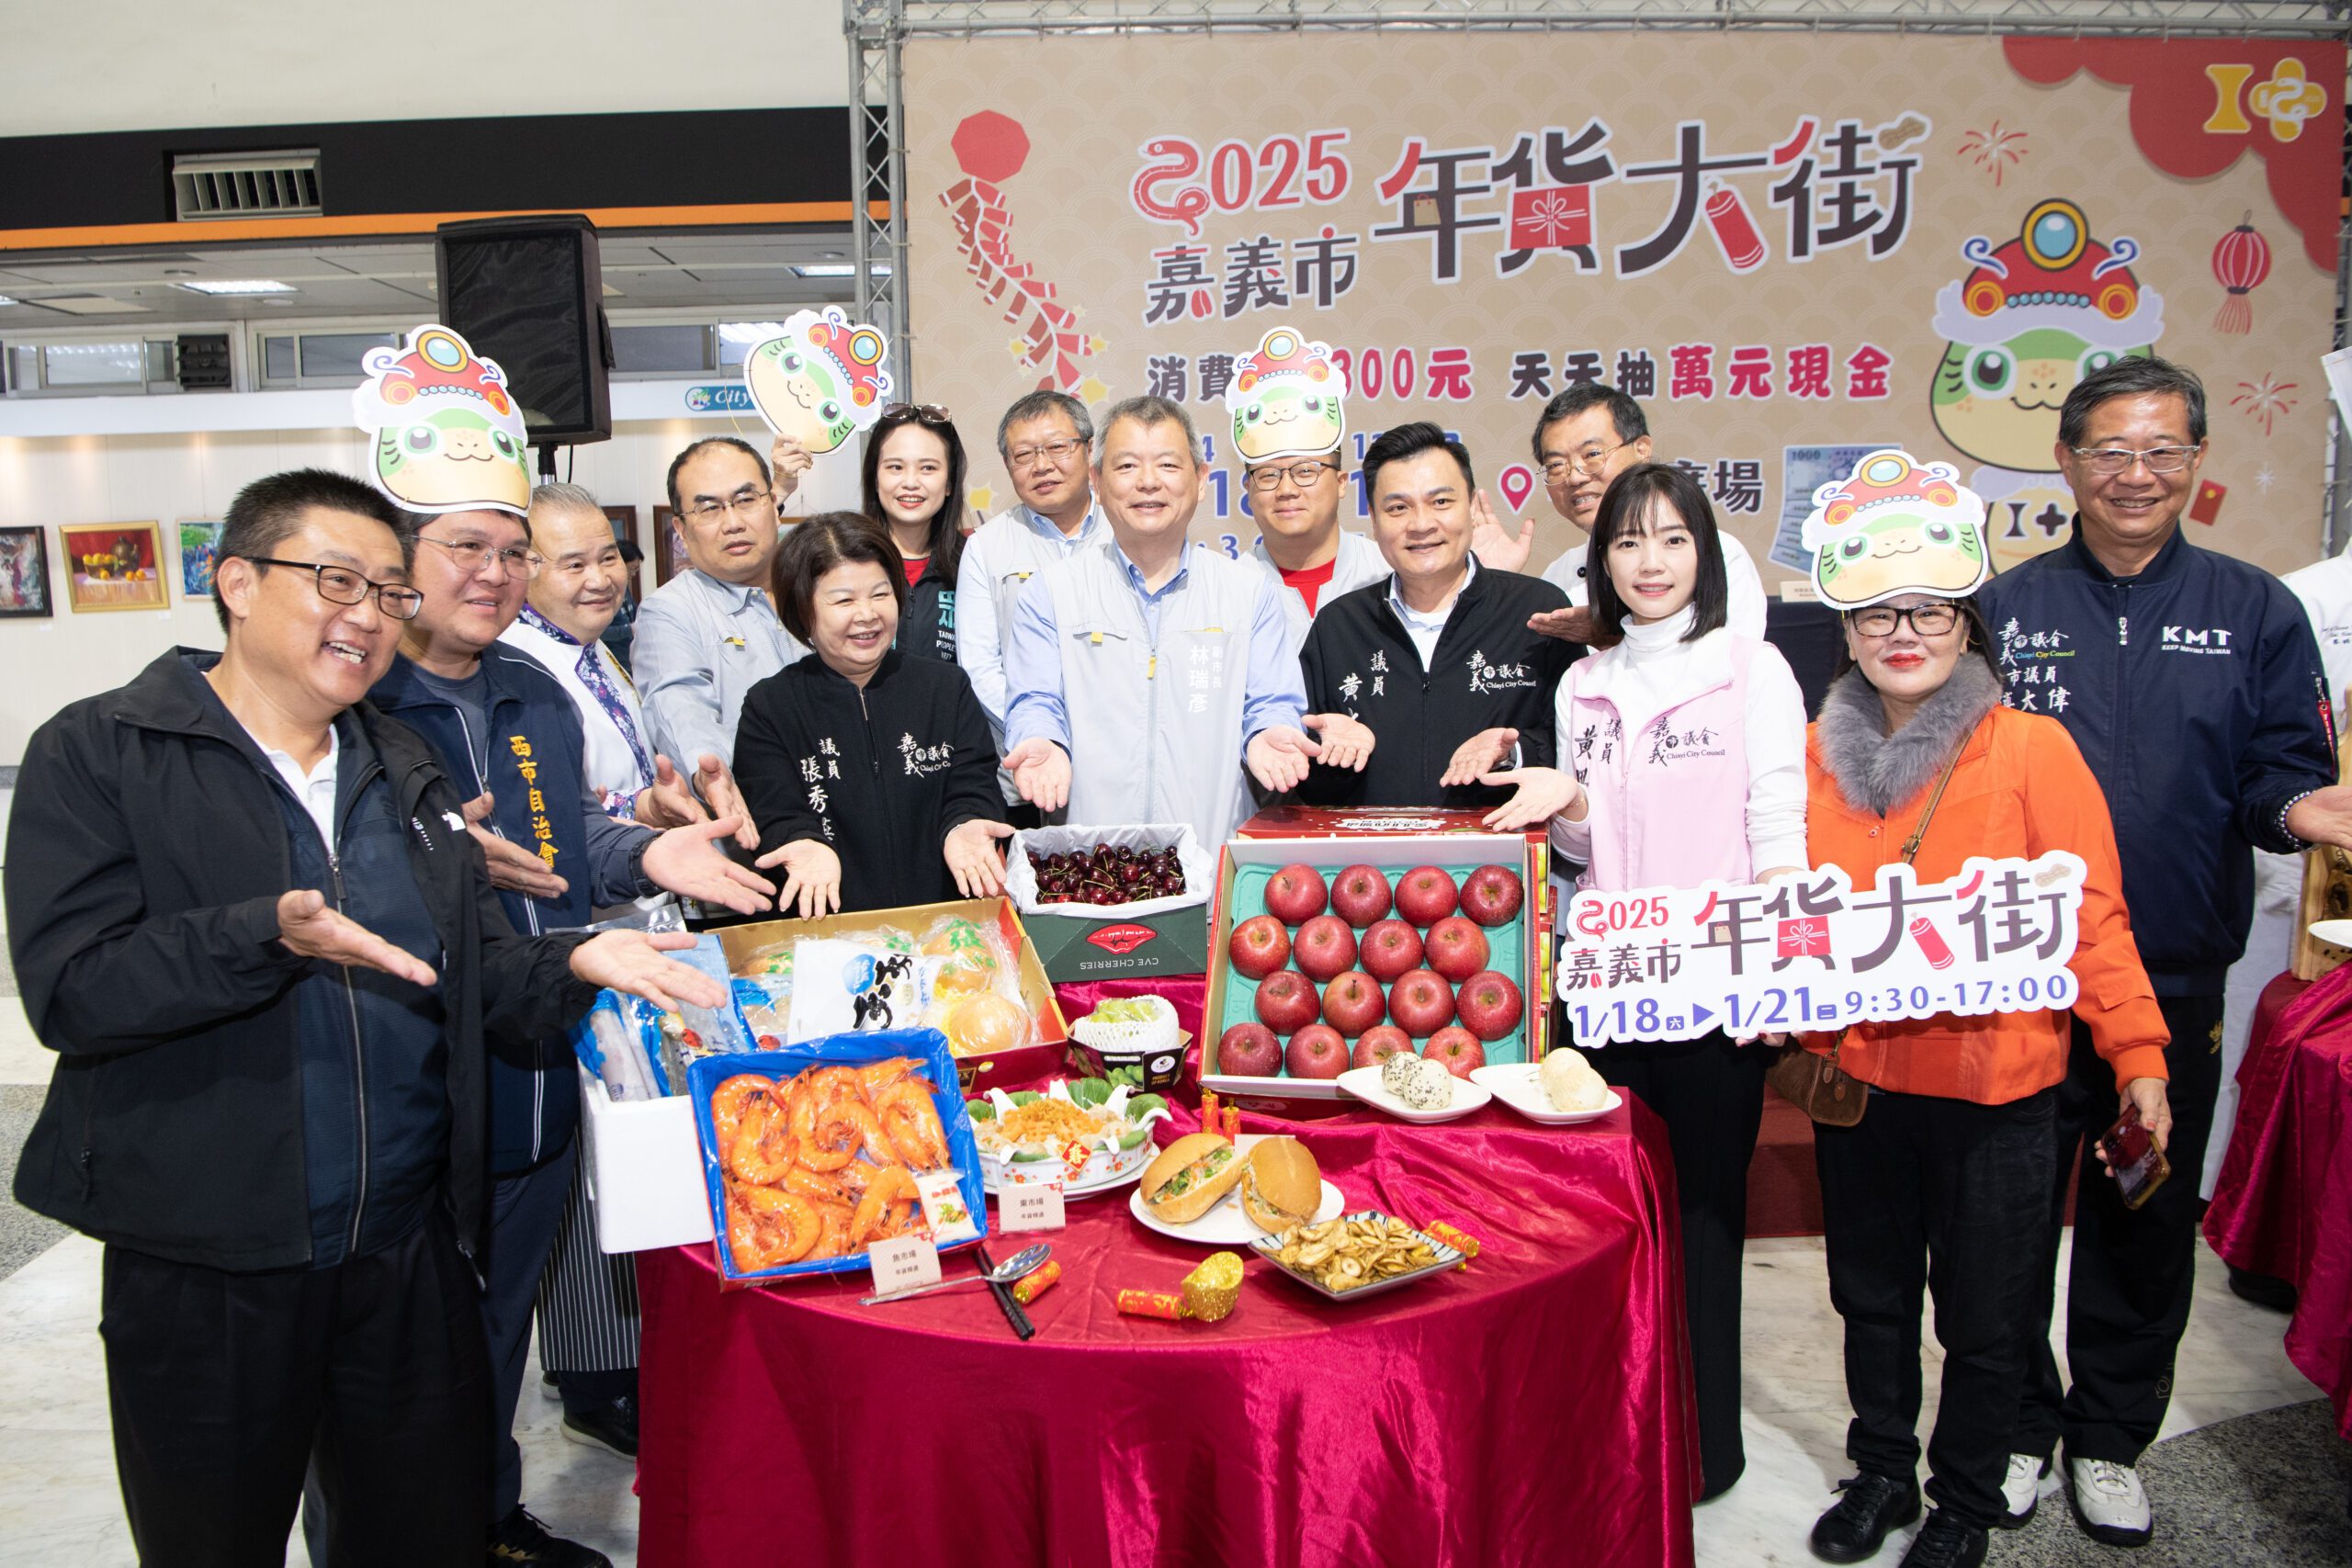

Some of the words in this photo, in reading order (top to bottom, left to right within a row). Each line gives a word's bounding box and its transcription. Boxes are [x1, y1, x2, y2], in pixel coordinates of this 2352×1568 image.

[1374, 118, 1928, 279] 年貨大街
[1146, 227, 1358, 324] 嘉義市
[715, 389, 751, 407] City
[2162, 626, 2233, 646] KMT
[1370, 649, 1390, 697] 議員
[2007, 665, 2057, 687] 市議員
[819, 738, 842, 780] 議員
[1600, 718, 1622, 765] 議員
[1667, 751, 1686, 761] Chiayi
[1701, 749, 1725, 757] Council
[509, 735, 560, 868] 西市自治會
[1690, 863, 2072, 976] 年貨大街
[1080, 959, 1135, 970] CHERRIES
[1566, 938, 1682, 991] 嘉義市
[1845, 975, 2067, 1015] 9:30-17:00
